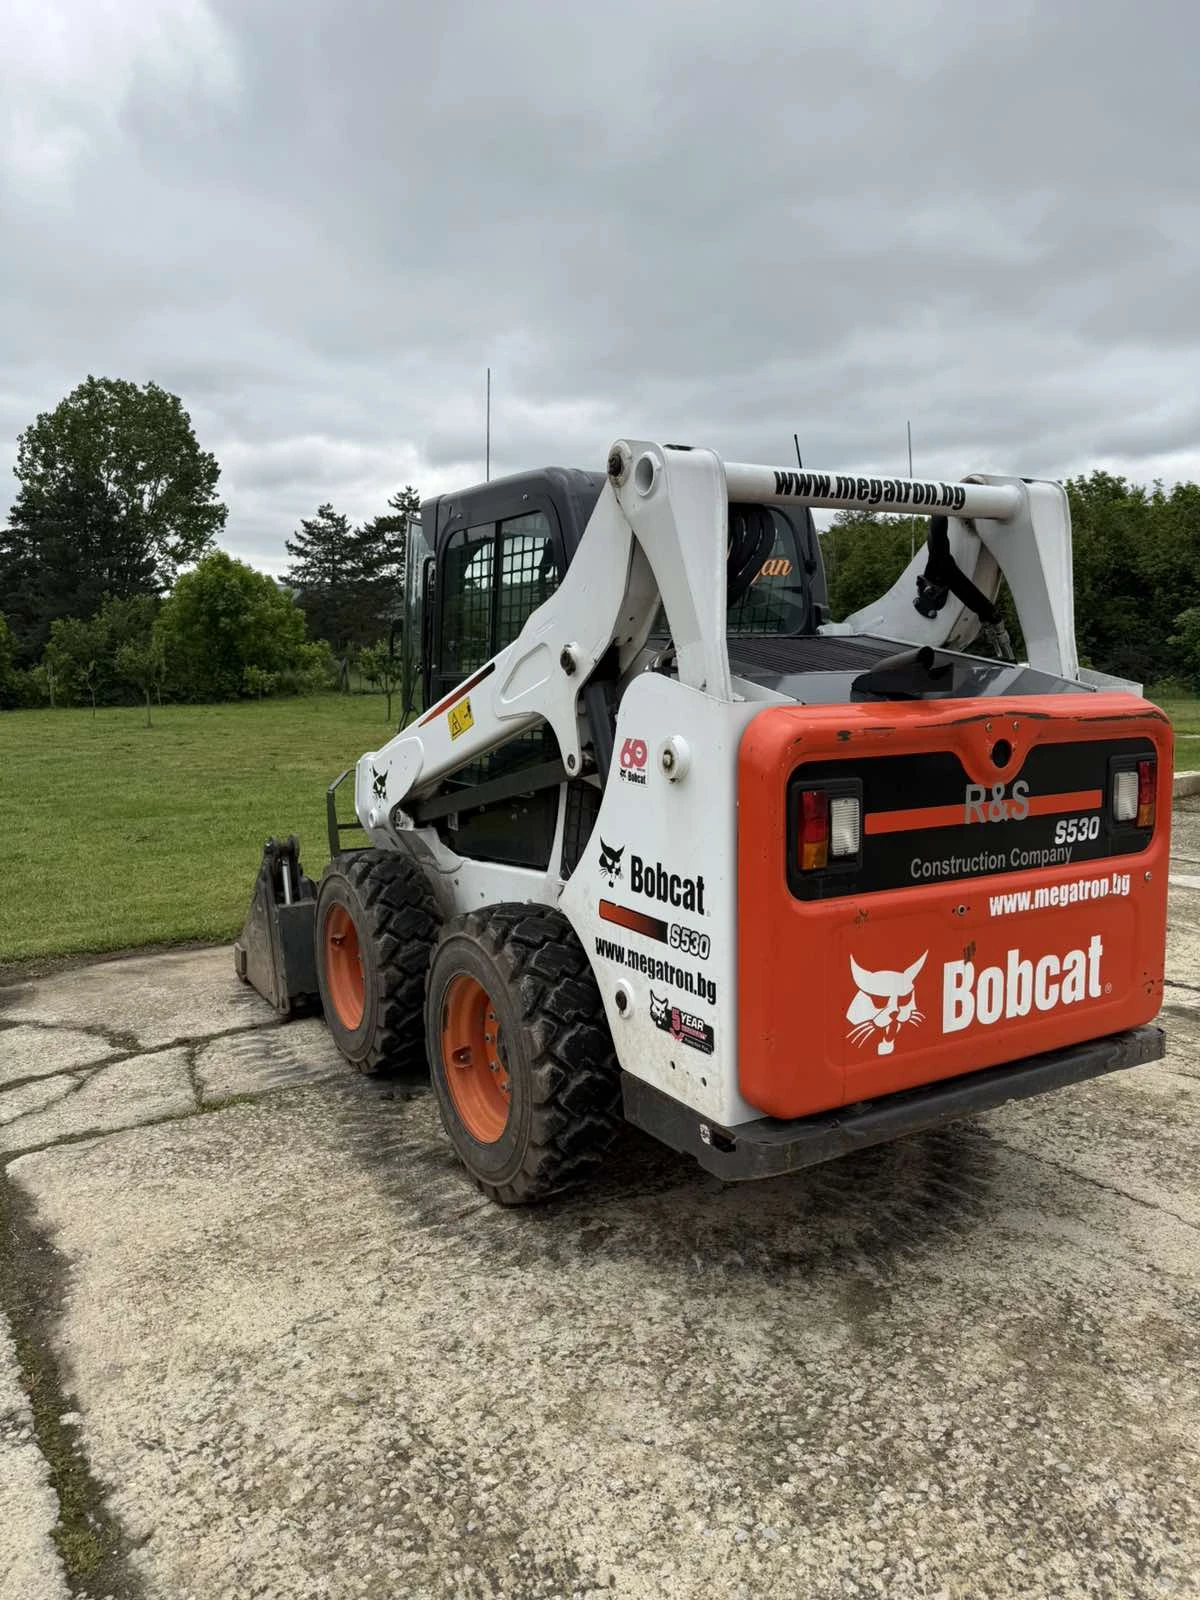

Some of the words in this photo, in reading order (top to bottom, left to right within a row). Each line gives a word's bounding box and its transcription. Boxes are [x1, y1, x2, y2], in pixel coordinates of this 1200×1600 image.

[774, 471, 966, 510] www.megatron.bg
[620, 738, 648, 768] 60
[628, 771, 646, 785] Bobcat
[964, 780, 1030, 824] R&S
[1054, 816, 1101, 845] S530
[910, 852, 1006, 879] Construction
[1010, 845, 1073, 869] Company
[631, 855, 705, 915] Bobcat
[989, 872, 1131, 917] www.megatron.bg
[670, 924, 710, 960] S530
[595, 937, 717, 1005] www.megatron.bg
[942, 934, 1103, 1034] Bobcat
[680, 1012, 704, 1032] YEAR
